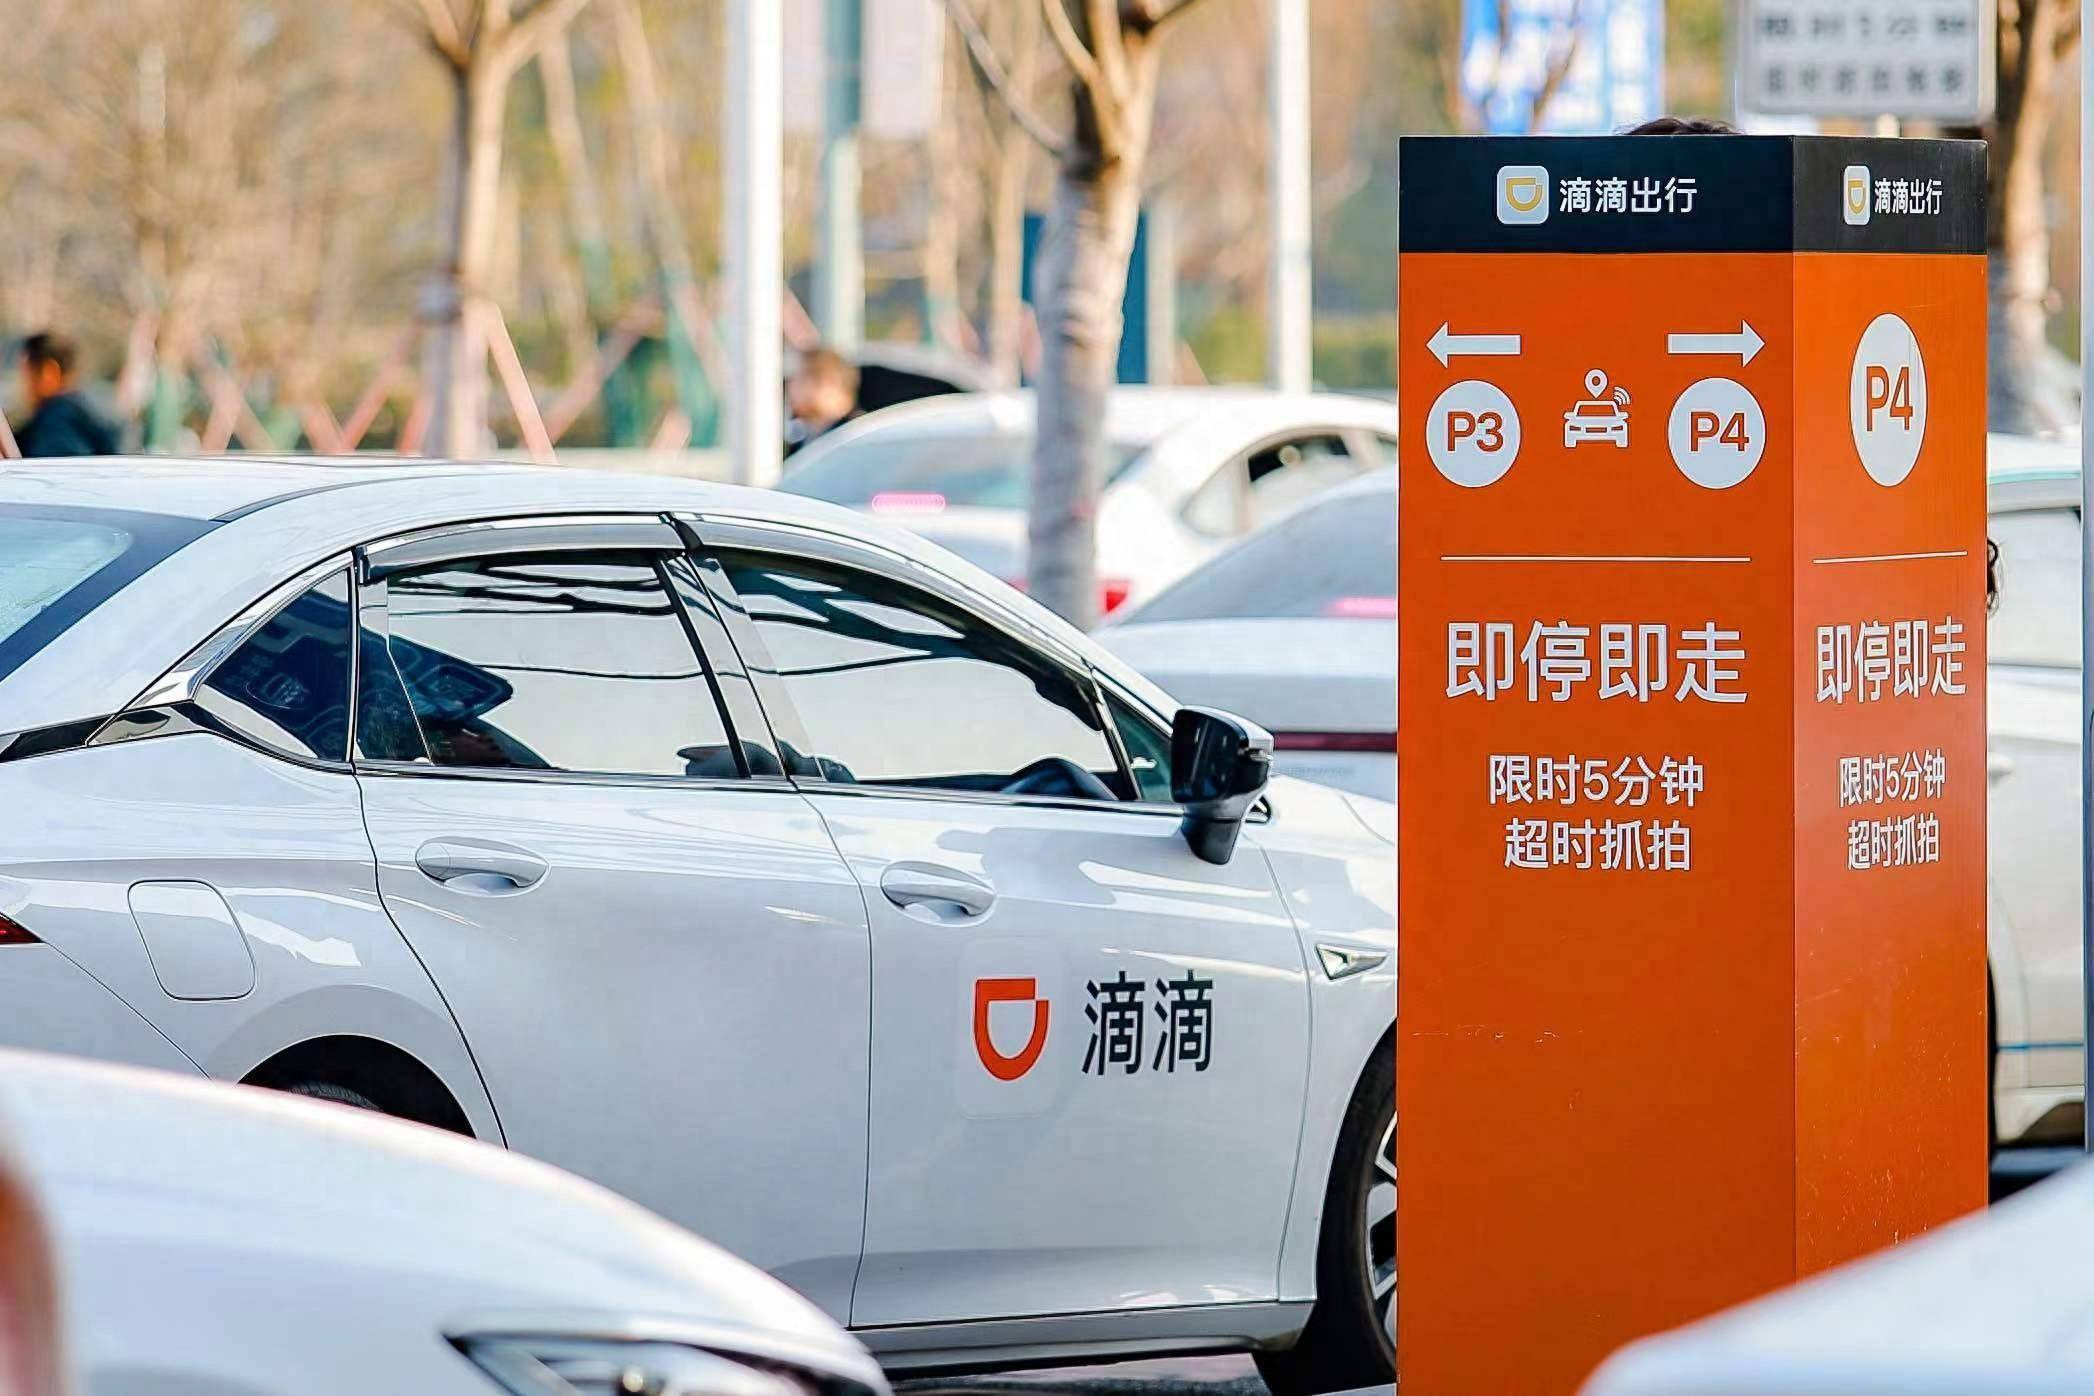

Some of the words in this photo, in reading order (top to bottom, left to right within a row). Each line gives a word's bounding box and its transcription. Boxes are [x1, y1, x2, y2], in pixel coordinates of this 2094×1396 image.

[1559, 175, 1698, 214] 滴滴出行
[1873, 177, 1943, 215] 滴滴出行
[1865, 364, 1914, 432] P4
[1447, 411, 1504, 452] P3
[1690, 410, 1750, 451] P4
[1445, 620, 1748, 703] 即停即走
[1816, 615, 1967, 704] 即停即走
[1488, 754, 1705, 807] 限时5分钟
[1838, 748, 1946, 807] 限时5分钟
[1503, 817, 1692, 871] 超时抓拍
[1846, 812, 1941, 870] 超时抓拍
[1081, 968, 1215, 1076] 滴滴
